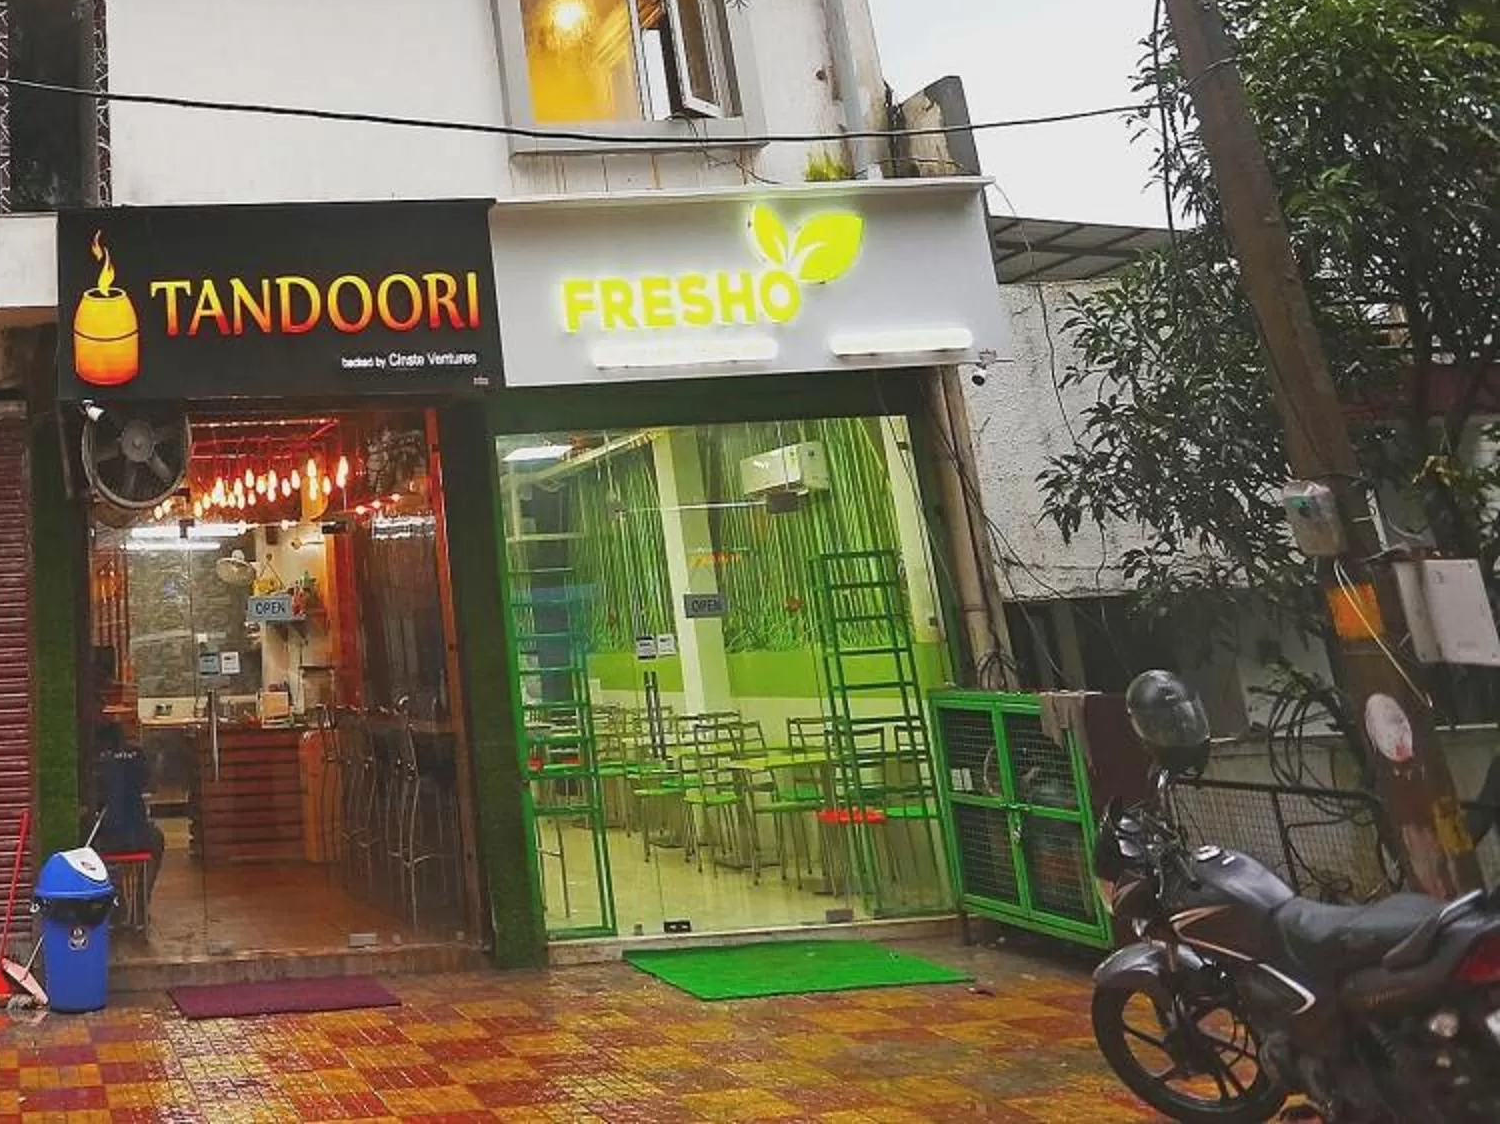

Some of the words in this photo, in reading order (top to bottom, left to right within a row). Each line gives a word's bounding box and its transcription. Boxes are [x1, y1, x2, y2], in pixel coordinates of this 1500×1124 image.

[150, 271, 482, 338] TANDOORI
[562, 270, 802, 332] FRESHO
[255, 601, 285, 615] OPEN
[691, 599, 724, 614] OPEN
